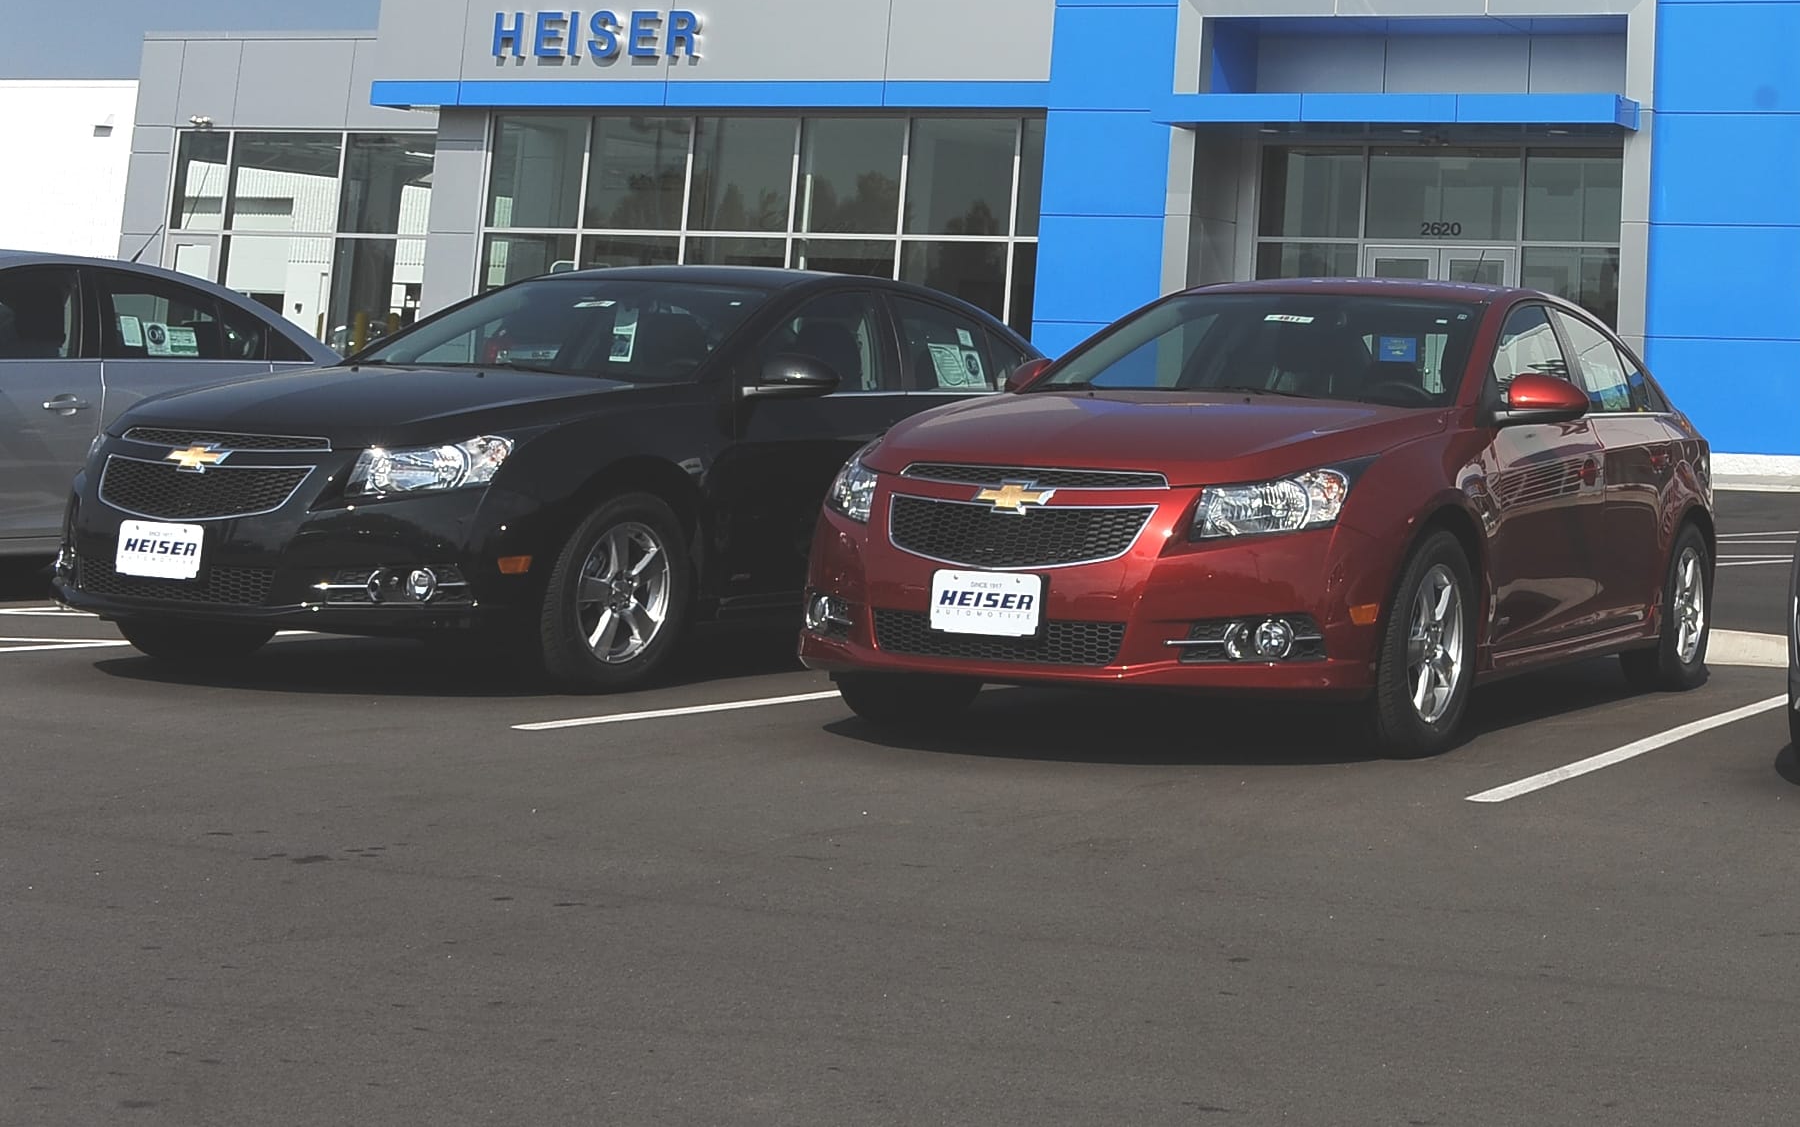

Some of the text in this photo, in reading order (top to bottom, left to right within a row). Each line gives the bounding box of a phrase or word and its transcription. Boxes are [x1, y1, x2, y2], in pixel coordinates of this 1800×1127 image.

[491, 9, 700, 59] HEISER
[1420, 222, 1462, 236] 2620
[124, 538, 197, 556] HEISER
[939, 590, 1034, 610] HEISER
[936, 609, 1030, 620] AUTOMOTIVE
